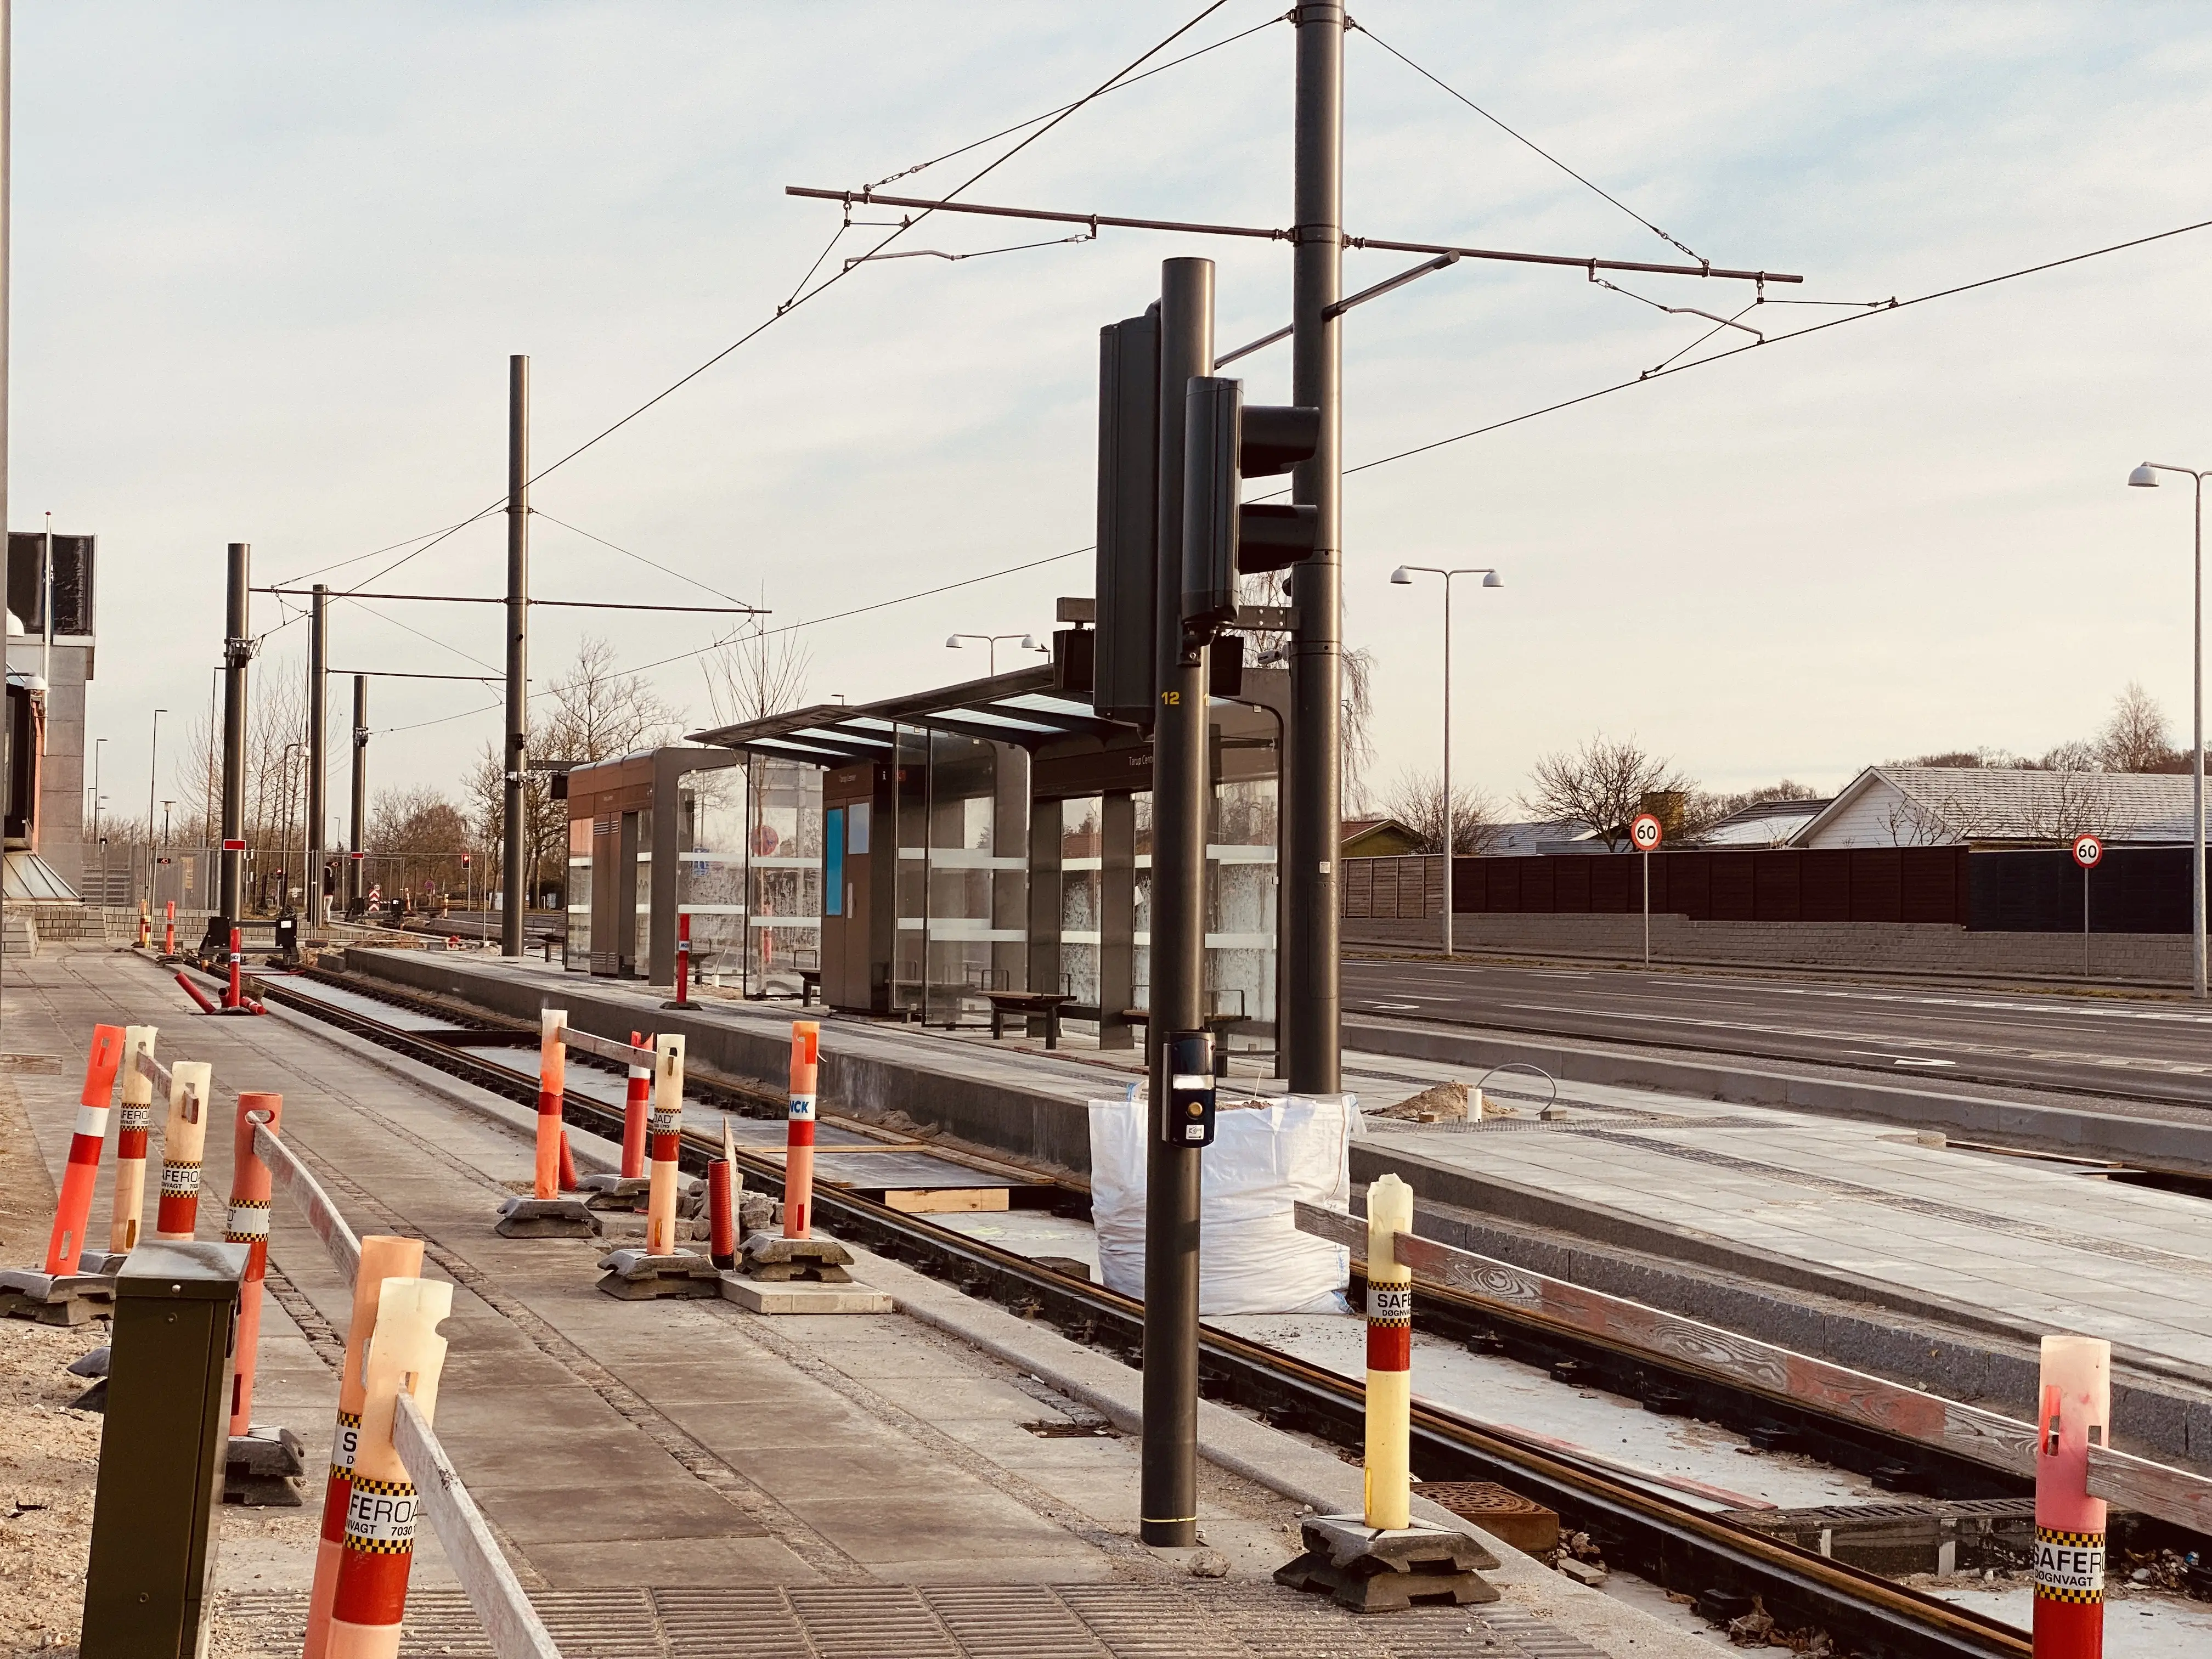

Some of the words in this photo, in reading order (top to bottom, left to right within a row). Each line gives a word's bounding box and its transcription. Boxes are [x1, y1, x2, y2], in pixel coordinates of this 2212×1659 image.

[1161, 691, 1180, 705] 12
[1637, 825, 1656, 840] 60
[2078, 844, 2097, 858] 60
[121, 1110, 149, 1120] FERO
[391, 1526, 412, 1536] 7030
[2035, 1568, 2094, 1587] DØGNVAGT
